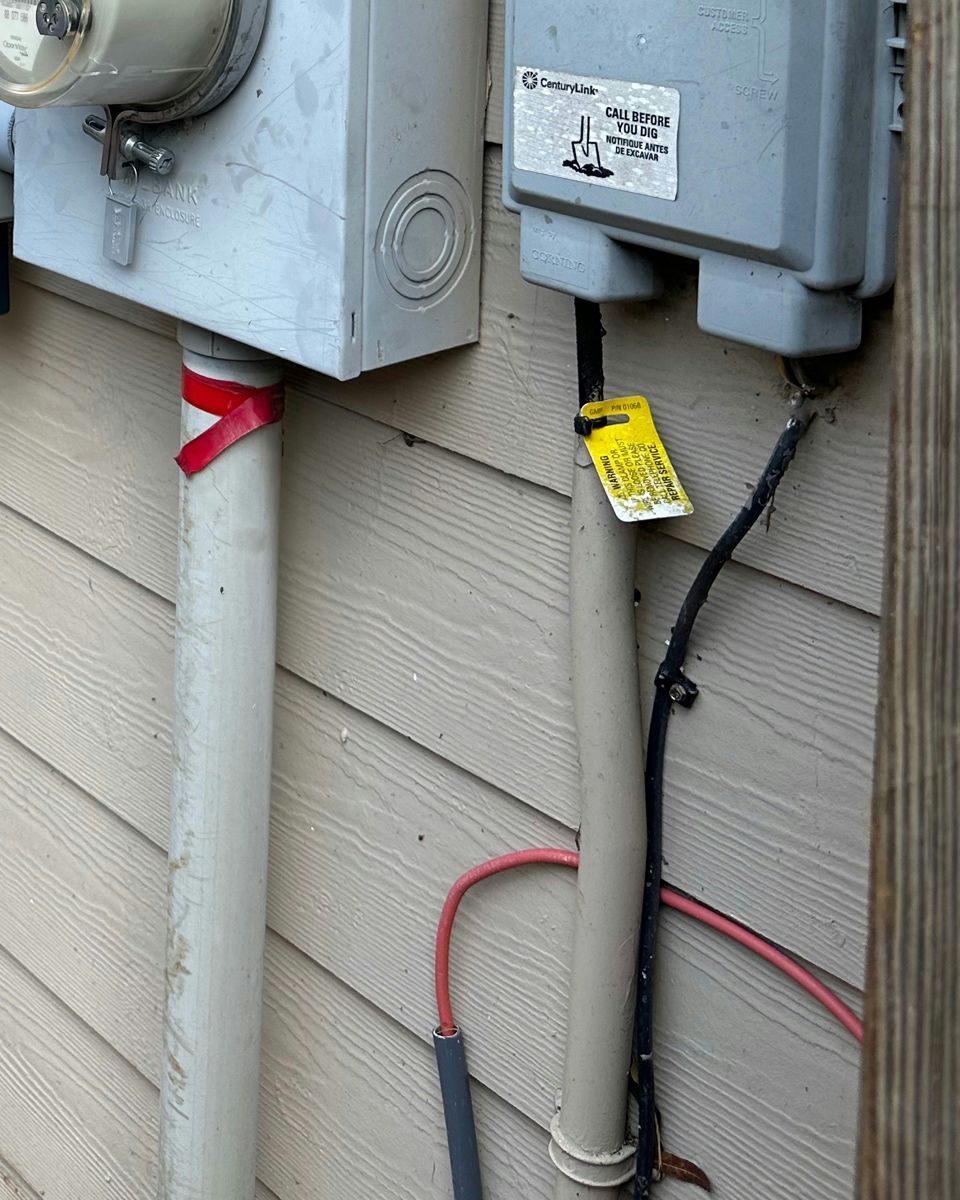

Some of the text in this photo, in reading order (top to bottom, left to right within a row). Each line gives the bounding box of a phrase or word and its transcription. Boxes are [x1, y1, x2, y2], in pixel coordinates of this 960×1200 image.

[697, 4, 749, 22] CUSTOMER
[711, 21, 748, 35] ACCESS
[540, 77, 596, 98] CenturyLink
[734, 85, 778, 101] SCREW
[605, 106, 670, 128] CALL BEFORE
[616, 121, 657, 139] YOU DIG
[605, 135, 668, 154] NOTIFIQUE ANTES
[615, 146, 658, 161] DE EXCAVAR
[155, 201, 200, 228] ENCLOSURE
[610, 449, 619, 458] OR
[615, 438, 629, 456] MUST
[626, 442, 642, 465] PLEASE
[614, 460, 630, 481] CLAMP
[623, 457, 633, 466] OR
[641, 453, 663, 488] TELEPHONE
[599, 455, 621, 489] WARNING
[627, 468, 643, 487] LOOSE
[638, 467, 657, 496] REMOVED
[662, 476, 680, 500] REPAIR
